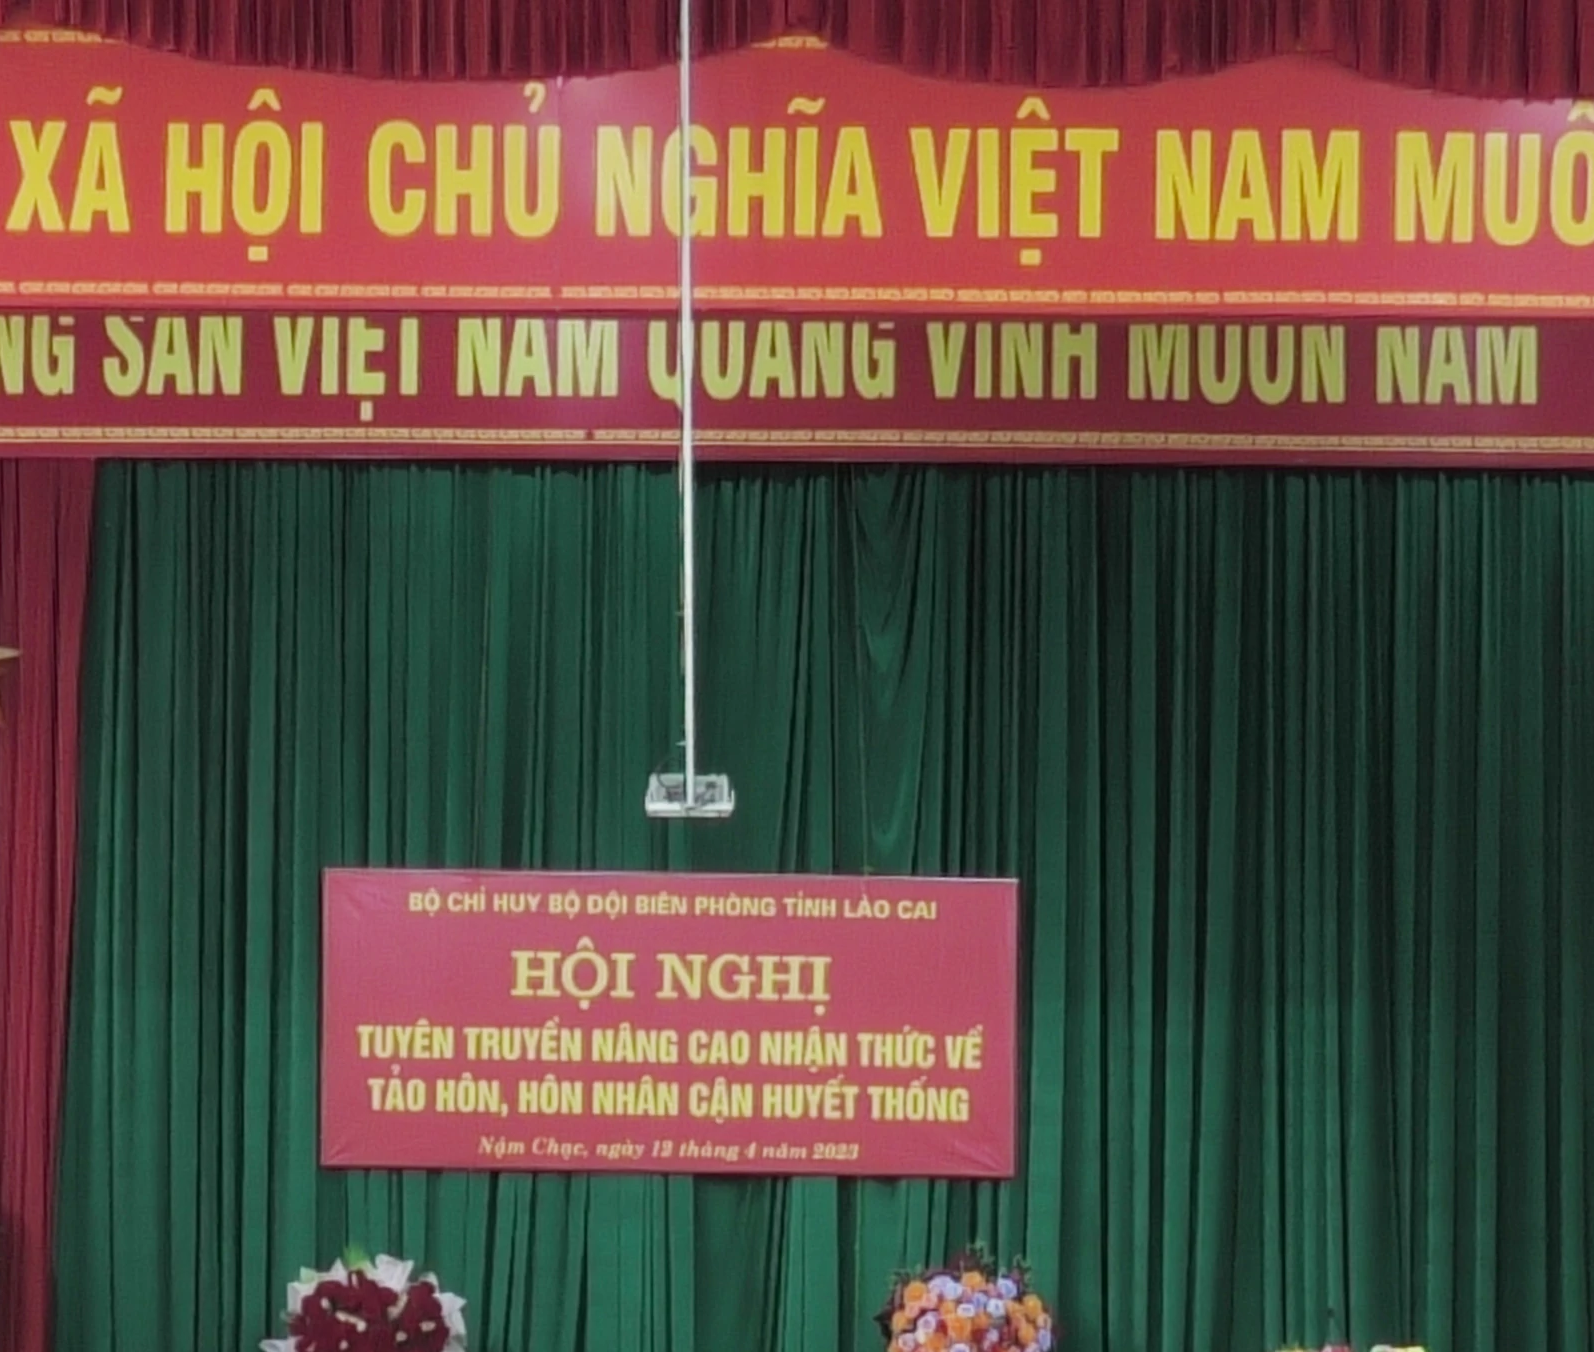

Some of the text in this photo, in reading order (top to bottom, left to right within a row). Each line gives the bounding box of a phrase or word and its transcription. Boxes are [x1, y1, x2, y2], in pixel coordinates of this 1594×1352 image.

[6, 87, 130, 233] XÃ
[165, 89, 323, 261] HỘI
[368, 82, 562, 238] CHỦ
[592, 97, 882, 238] NGHĨA
[910, 97, 1119, 265] VIỆT
[1156, 129, 1360, 242] NAM
[409, 888, 441, 915] BỘ
[447, 887, 485, 912] CHỈ
[493, 893, 541, 913] HUY
[549, 890, 581, 918] BỘ
[635, 892, 687, 915] BIÊN
[695, 893, 776, 916] PHÒNG
[783, 892, 836, 917] TỈNH
[844, 895, 891, 918] LÀO
[897, 900, 936, 919] CAI
[511, 937, 831, 1015] HỘI NGHỊ
[357, 1019, 454, 1060] TUYÊN
[463, 1017, 582, 1062] TRUYỀN
[592, 1023, 678, 1063] NÂNG
[688, 1030, 750, 1065] CAO
[760, 1026, 847, 1072] NHẬN
[857, 1026, 935, 1068] THỨC
[368, 1065, 970, 1123] TẢO HÔN, HÔN NHÂN CẬN HUYẾT THỐNG
